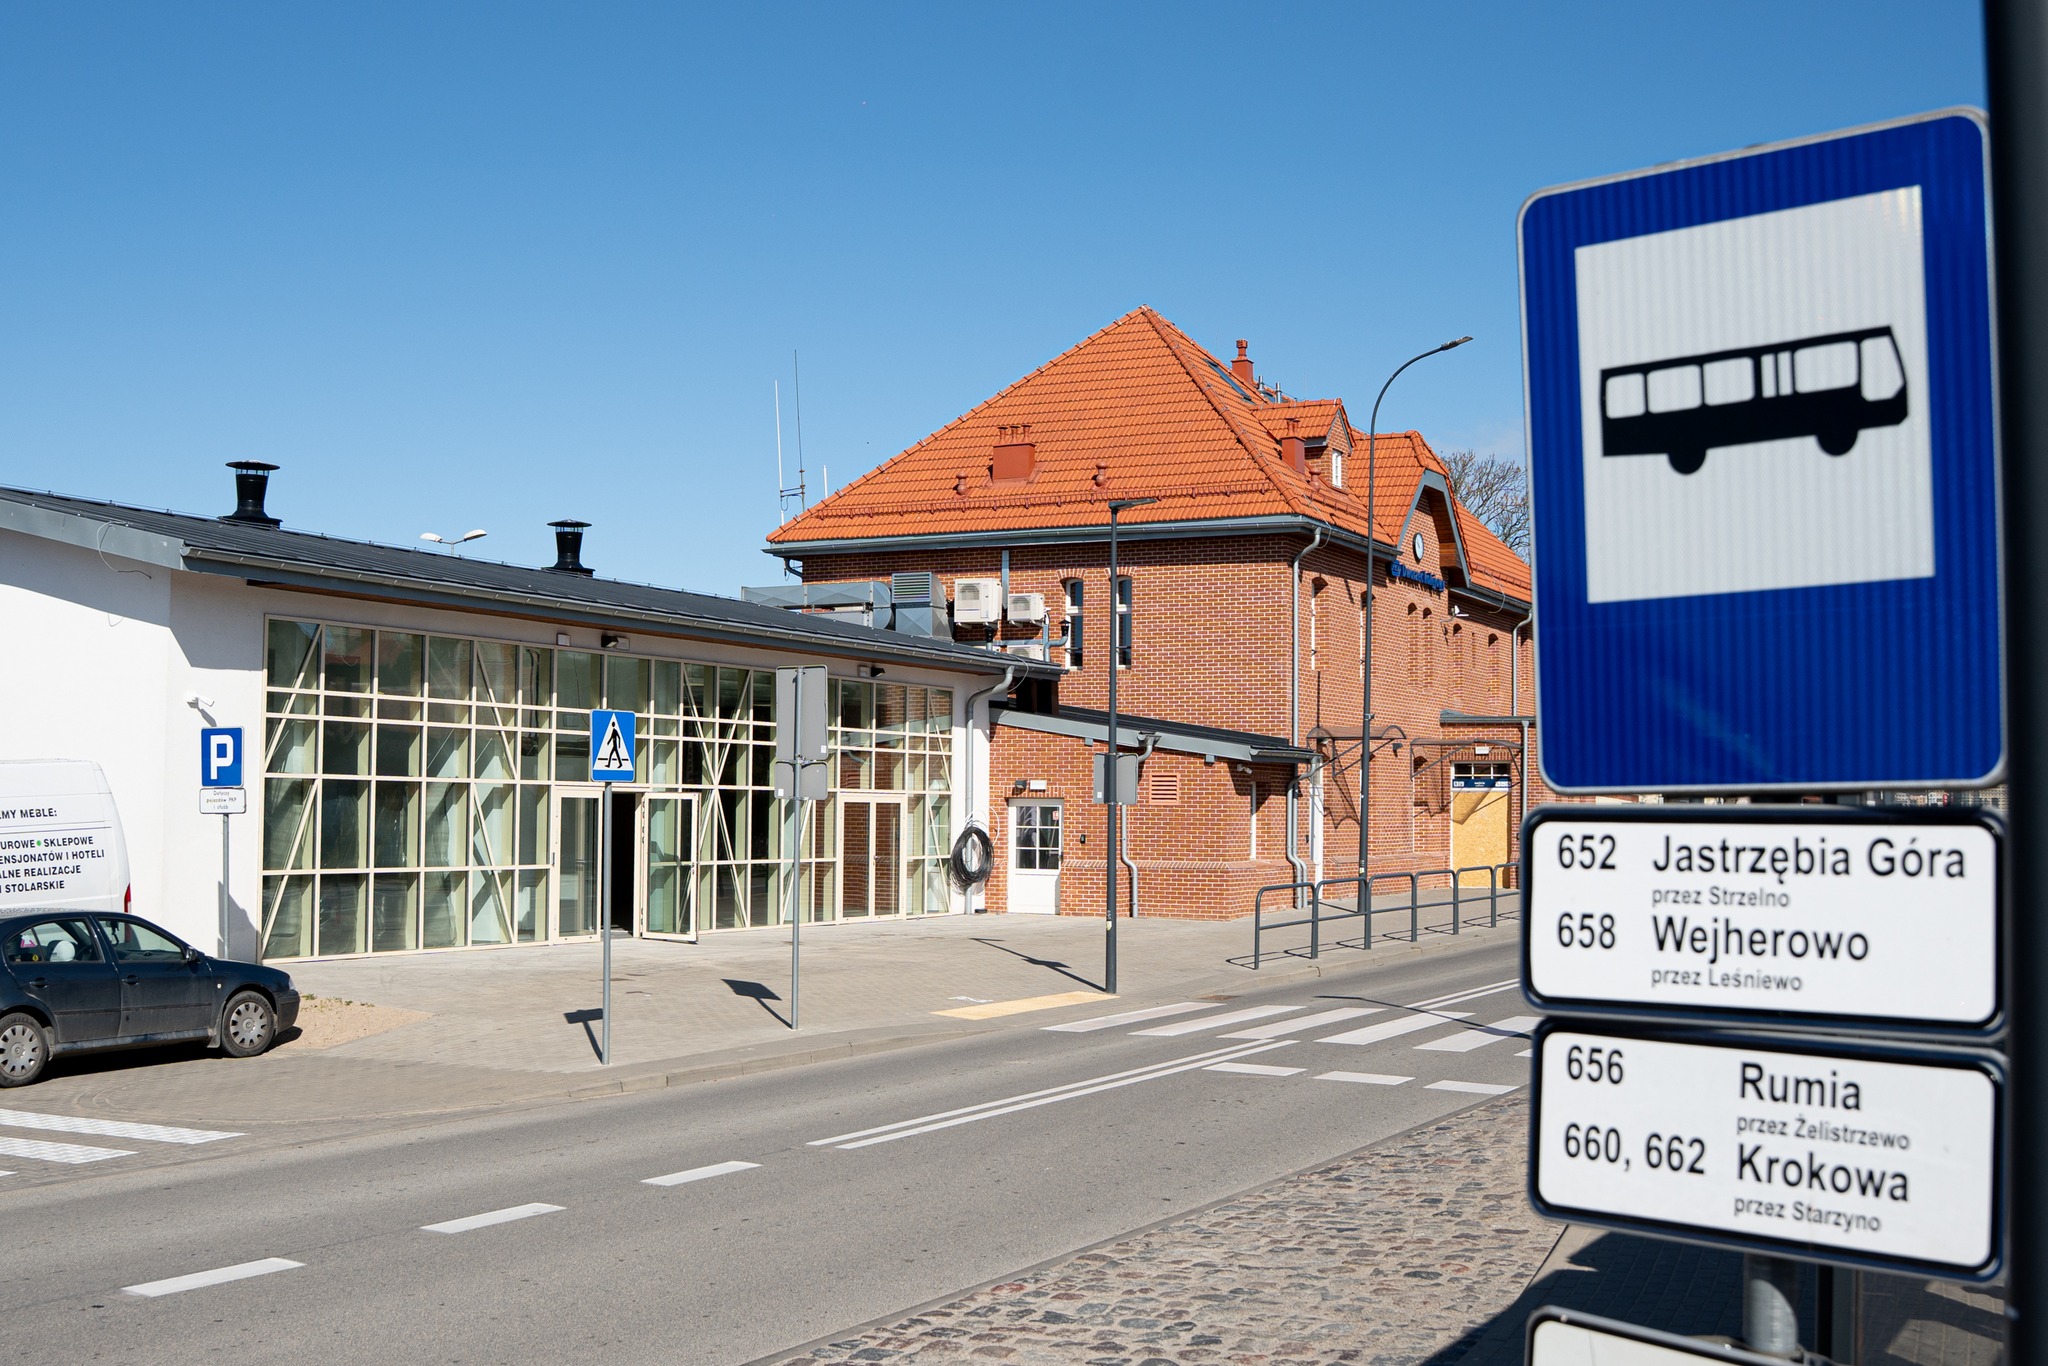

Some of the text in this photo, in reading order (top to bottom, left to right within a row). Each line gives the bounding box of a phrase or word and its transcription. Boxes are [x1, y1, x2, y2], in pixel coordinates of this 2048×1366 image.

[210, 734, 234, 780] P
[0, 807, 57, 820] MY MEBLE:
[43, 836, 94, 848] SKLEPOWE
[66, 851, 69, 860] I
[71, 849, 105, 860] HOTELI
[24, 865, 82, 878] REALIZACJE
[1558, 834, 1966, 885] 652 Jastrzębia Góra
[5, 880, 65, 894] STOLARSKIE
[1651, 885, 1790, 908] przez Strzelno
[1557, 912, 1870, 965] 658 Wejherowo
[1651, 967, 1804, 992] przez Leśniewo
[1566, 1045, 1862, 1111] 656 Rumia
[1736, 1113, 1911, 1151] przez Żelistrzewo
[1564, 1123, 1910, 1203] 660, 662 Krokowa
[1733, 1197, 1882, 1233] przez Starzyno
